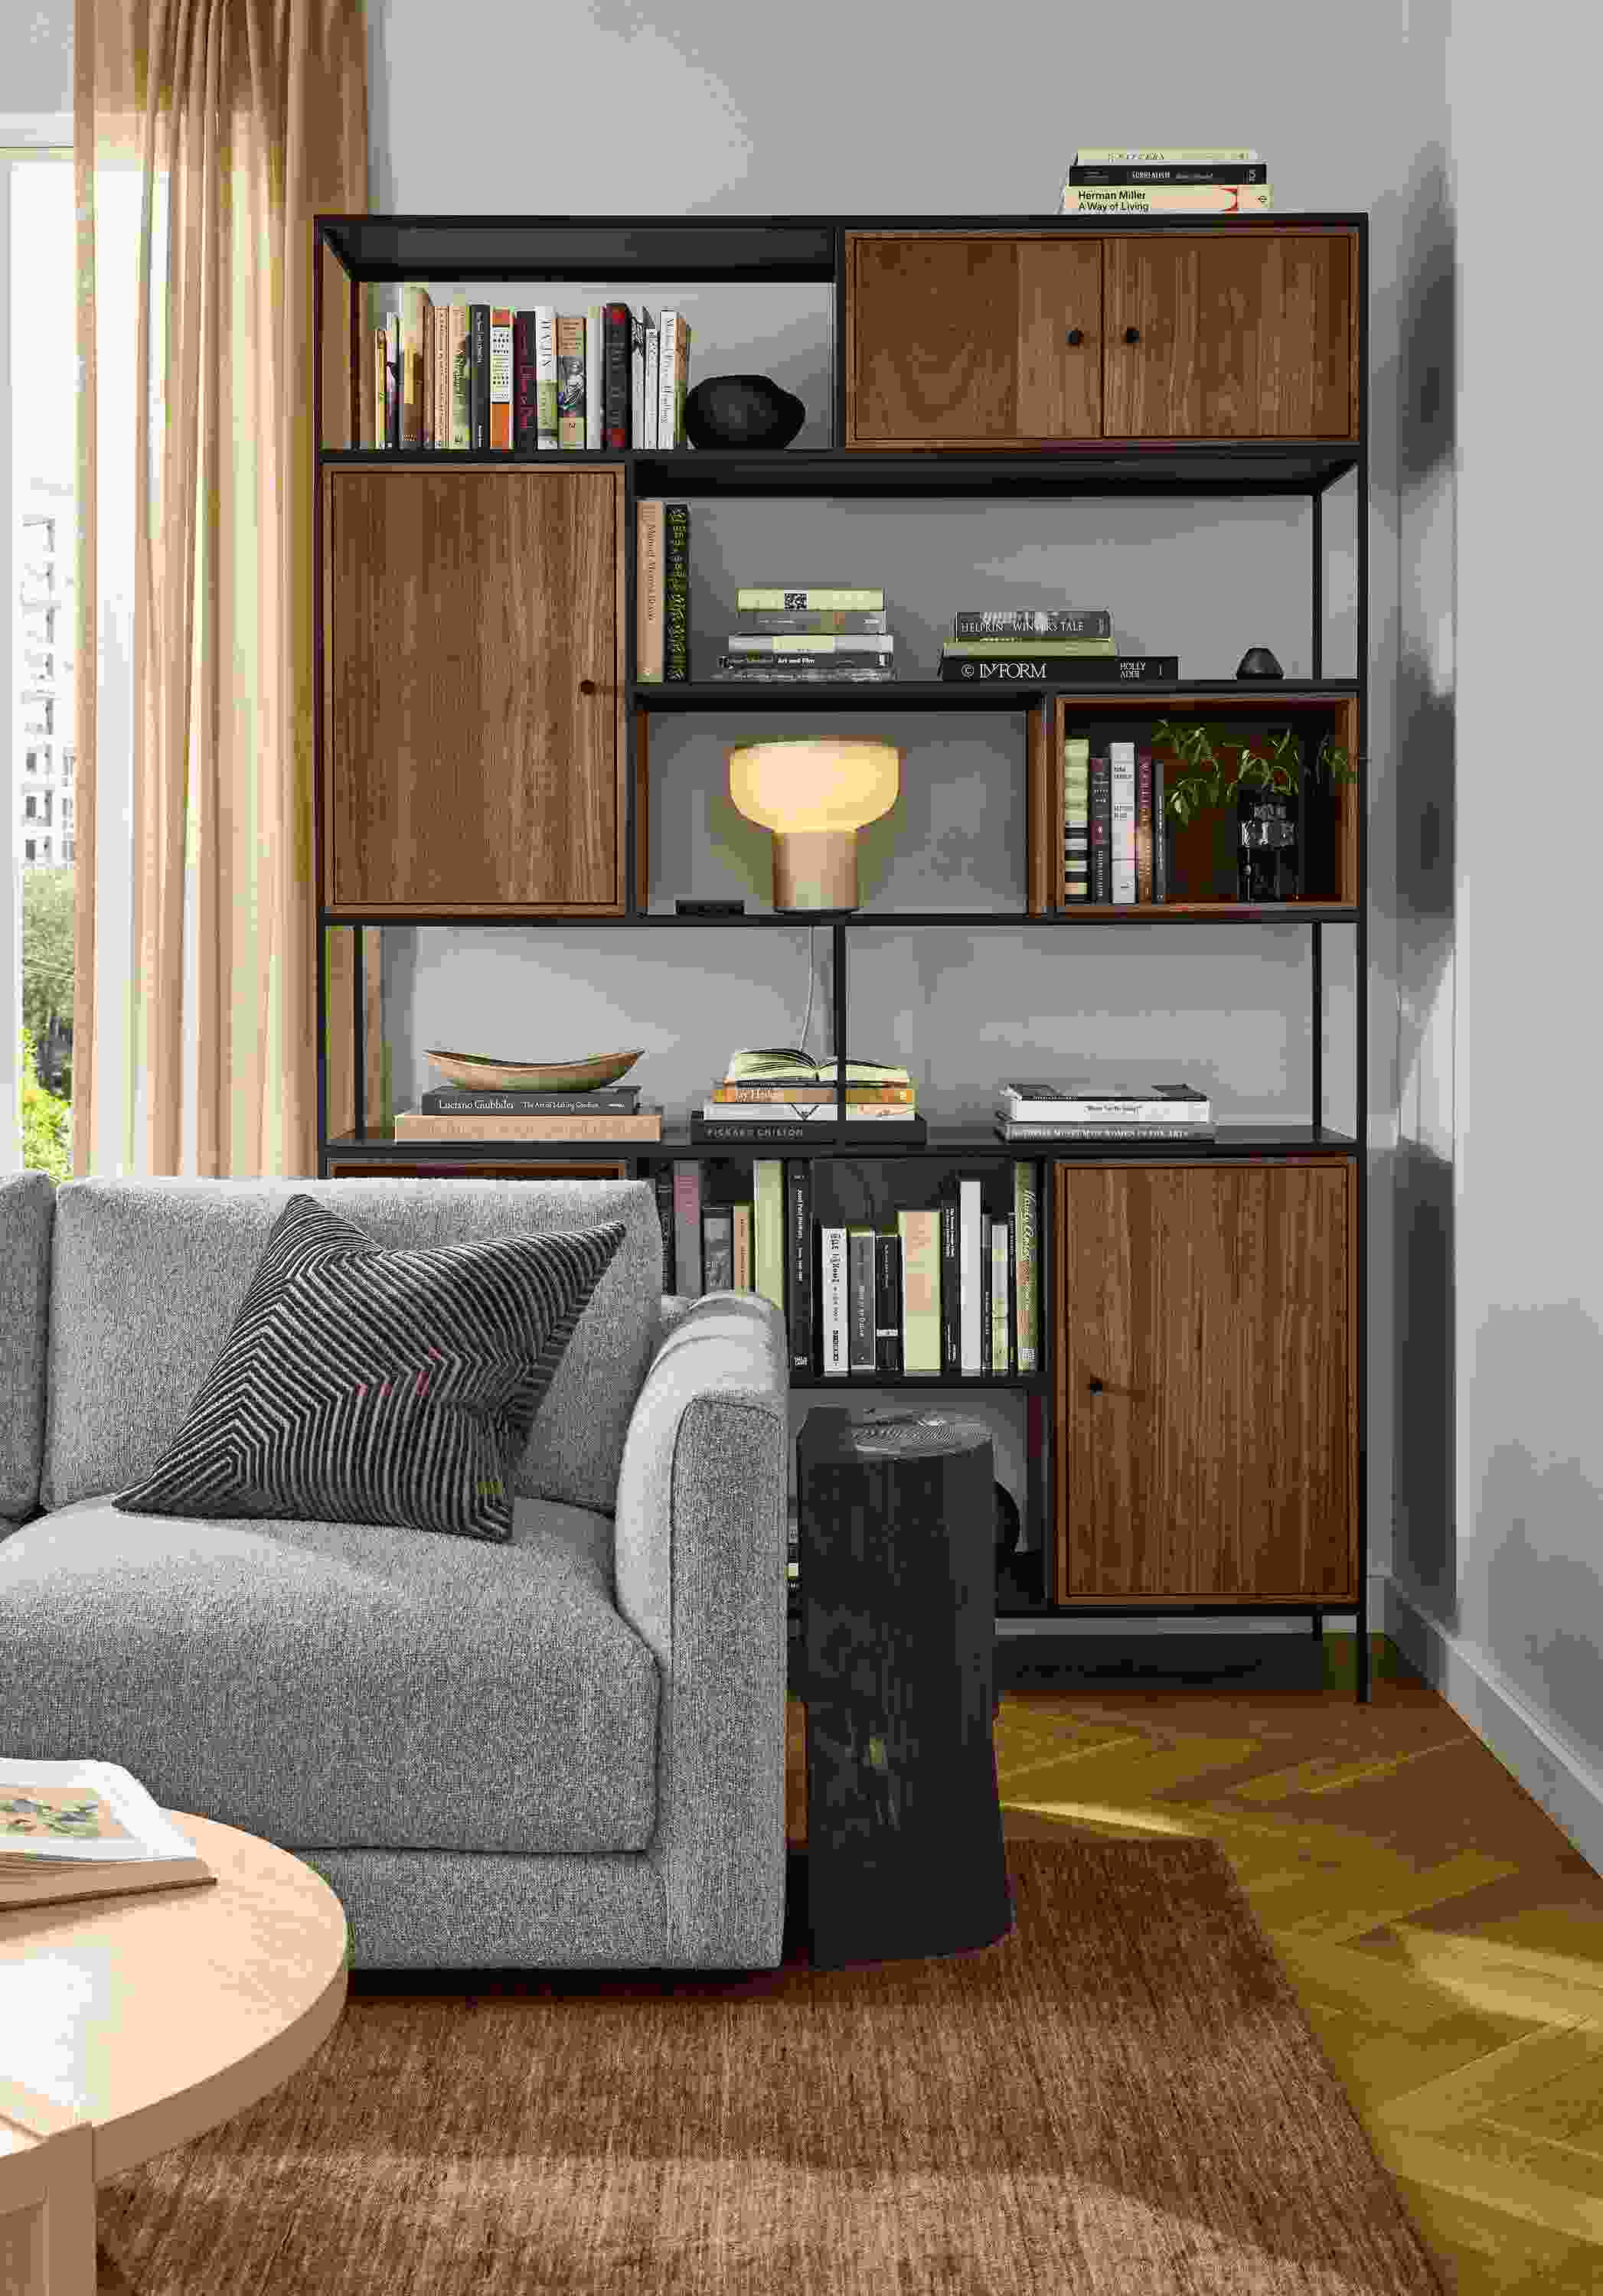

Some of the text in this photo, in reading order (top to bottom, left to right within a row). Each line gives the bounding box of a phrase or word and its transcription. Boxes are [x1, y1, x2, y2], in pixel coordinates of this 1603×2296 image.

[1078, 191, 1146, 200] Herman Miller
[1079, 201, 1149, 212] A Way of Living
[961, 622, 1004, 631] HELPRIN
[1060, 621, 1084, 631] TALE
[439, 1099, 472, 1109] Luciano
